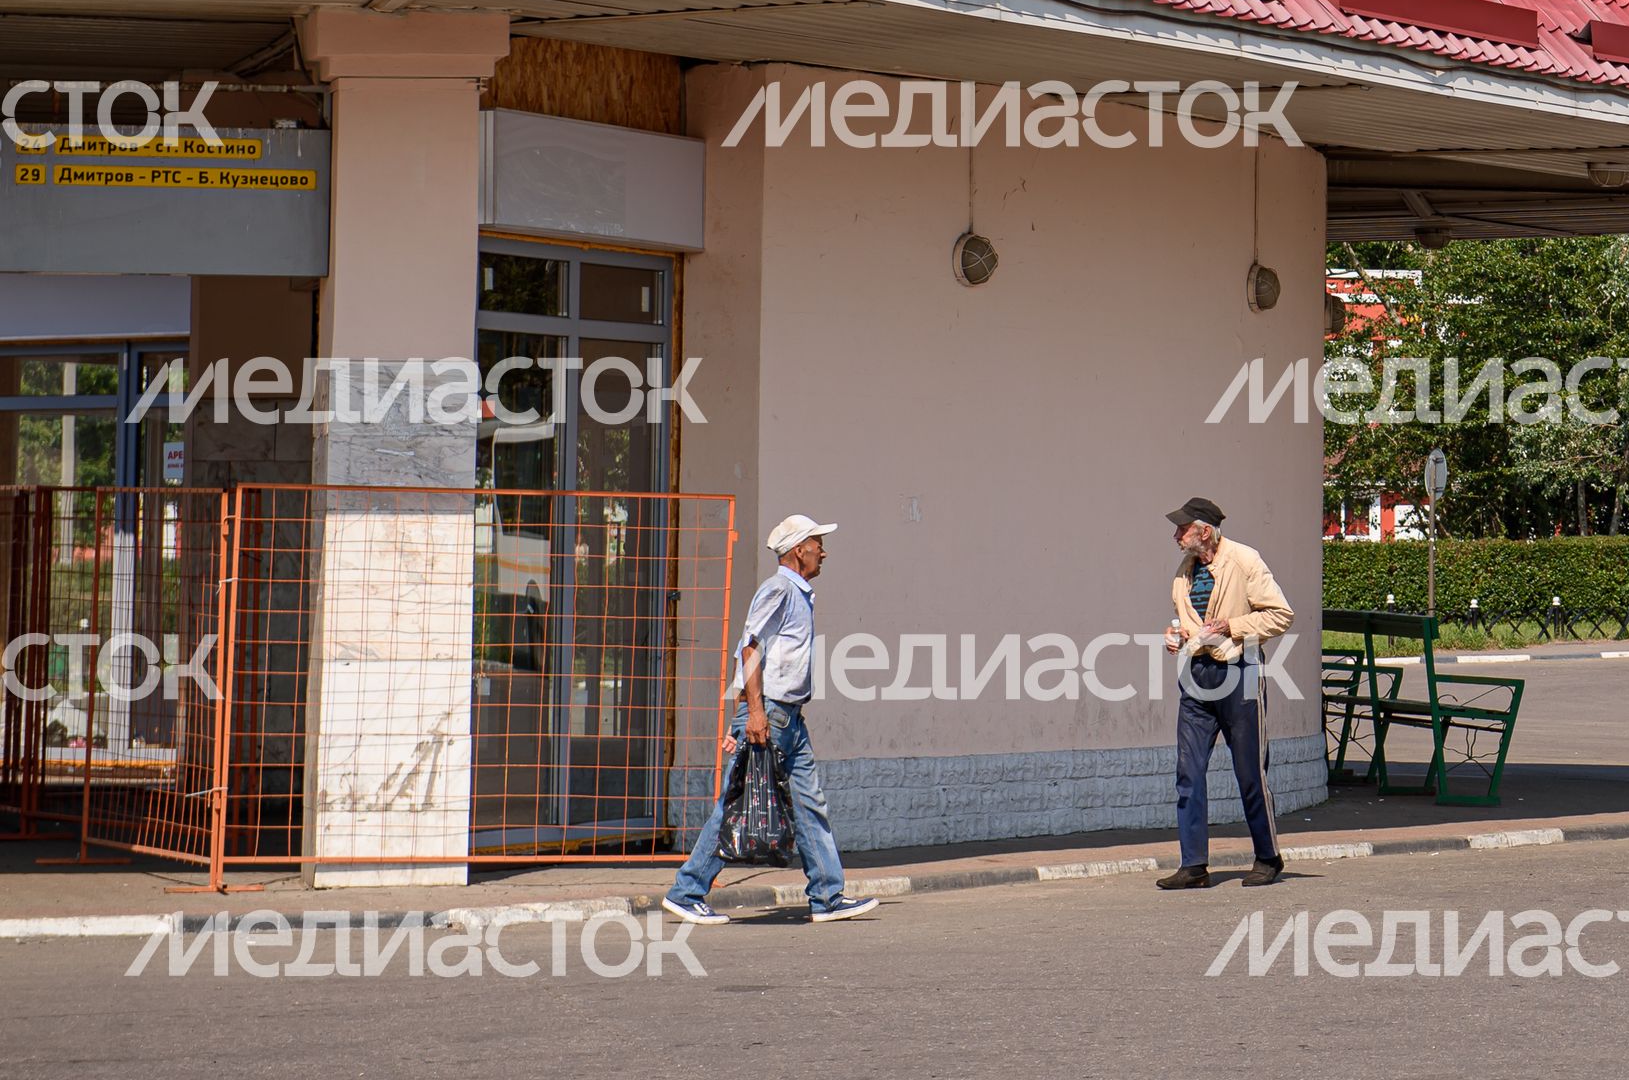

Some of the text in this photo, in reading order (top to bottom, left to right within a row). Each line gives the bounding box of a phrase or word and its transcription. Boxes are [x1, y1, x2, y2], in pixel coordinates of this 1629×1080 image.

[20, 138, 41, 152] 24
[60, 137, 138, 154] Дмитров
[184, 140, 257, 155] Костино
[20, 167, 40, 182] 29
[59, 167, 134, 185] Дмитров
[151, 170, 182, 183] РТС
[198, 171, 214, 184] Б.
[219, 172, 309, 187] Кузнецово
